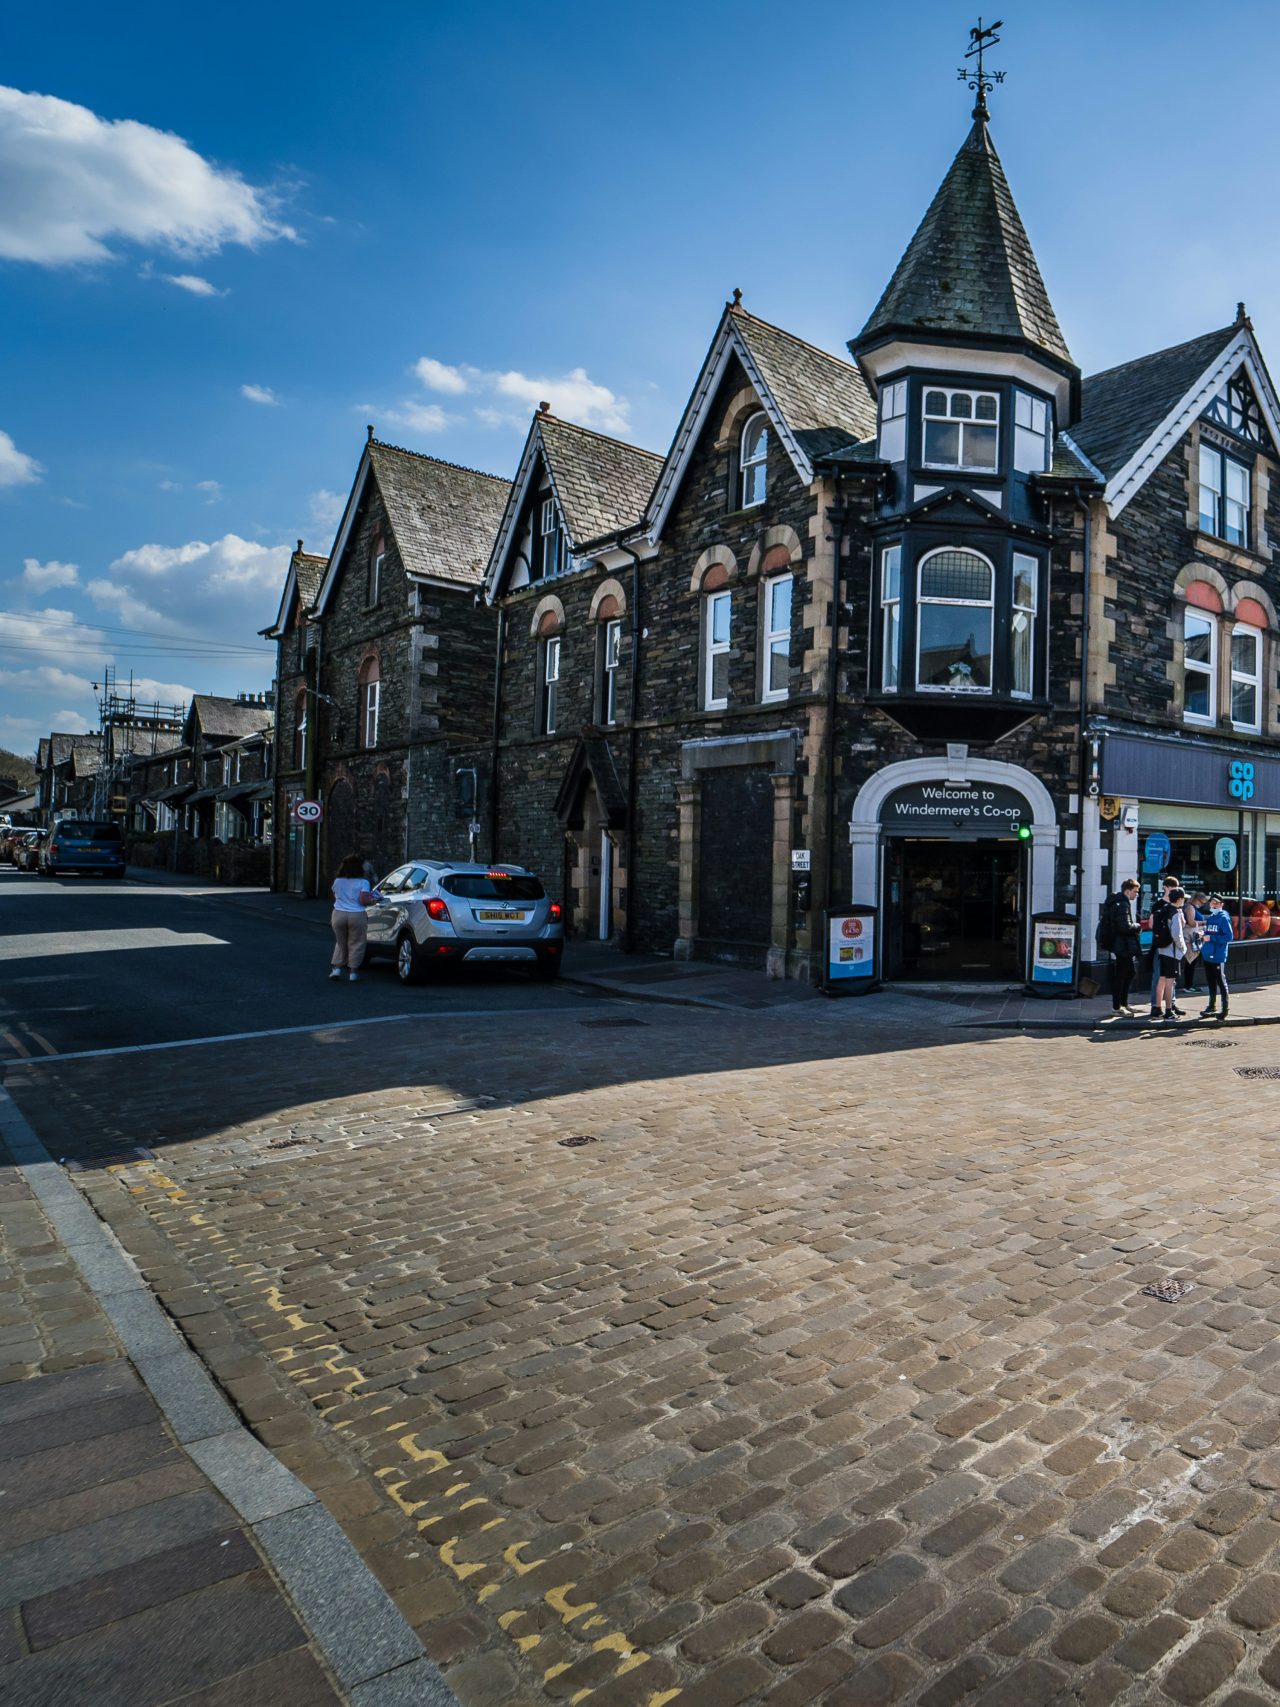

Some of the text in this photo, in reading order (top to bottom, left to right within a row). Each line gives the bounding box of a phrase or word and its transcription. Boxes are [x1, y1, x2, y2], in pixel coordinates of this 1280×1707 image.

[922, 787, 995, 800] Welcome to
[299, 806, 319, 816] 30
[895, 803, 1021, 819] Windermere's Co-op
[791, 861, 809, 869] STREET
